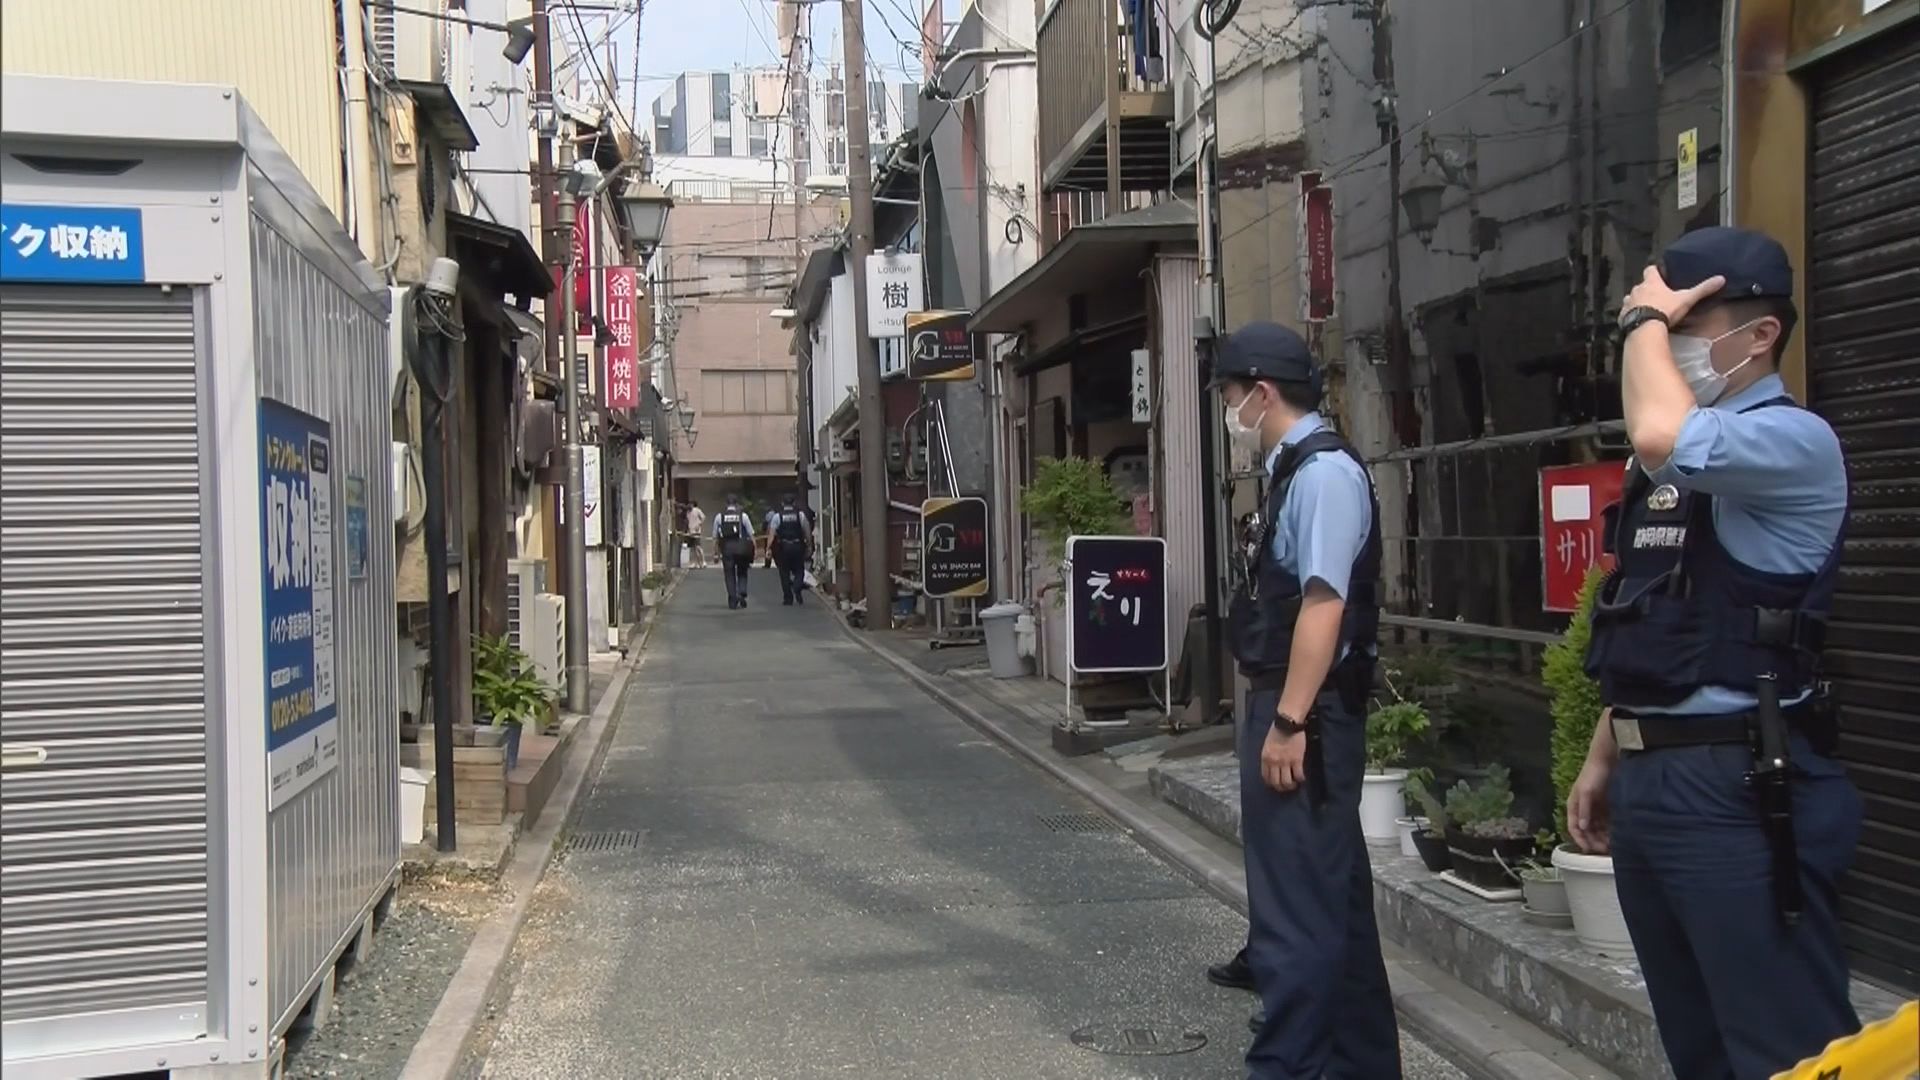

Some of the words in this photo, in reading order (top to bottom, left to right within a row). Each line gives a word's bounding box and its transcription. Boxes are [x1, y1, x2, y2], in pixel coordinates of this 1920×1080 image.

[2, 223, 129, 260] ク収納
[878, 265, 912, 275] Lounge
[610, 272, 632, 347] 釜山港
[882, 281, 909, 309] 樹
[878, 316, 905, 327] -itsu
[612, 357, 632, 401] 焼肉
[267, 433, 308, 473] トランクルーム
[266, 475, 311, 590] 収納
[1087, 570, 1141, 626] えり
